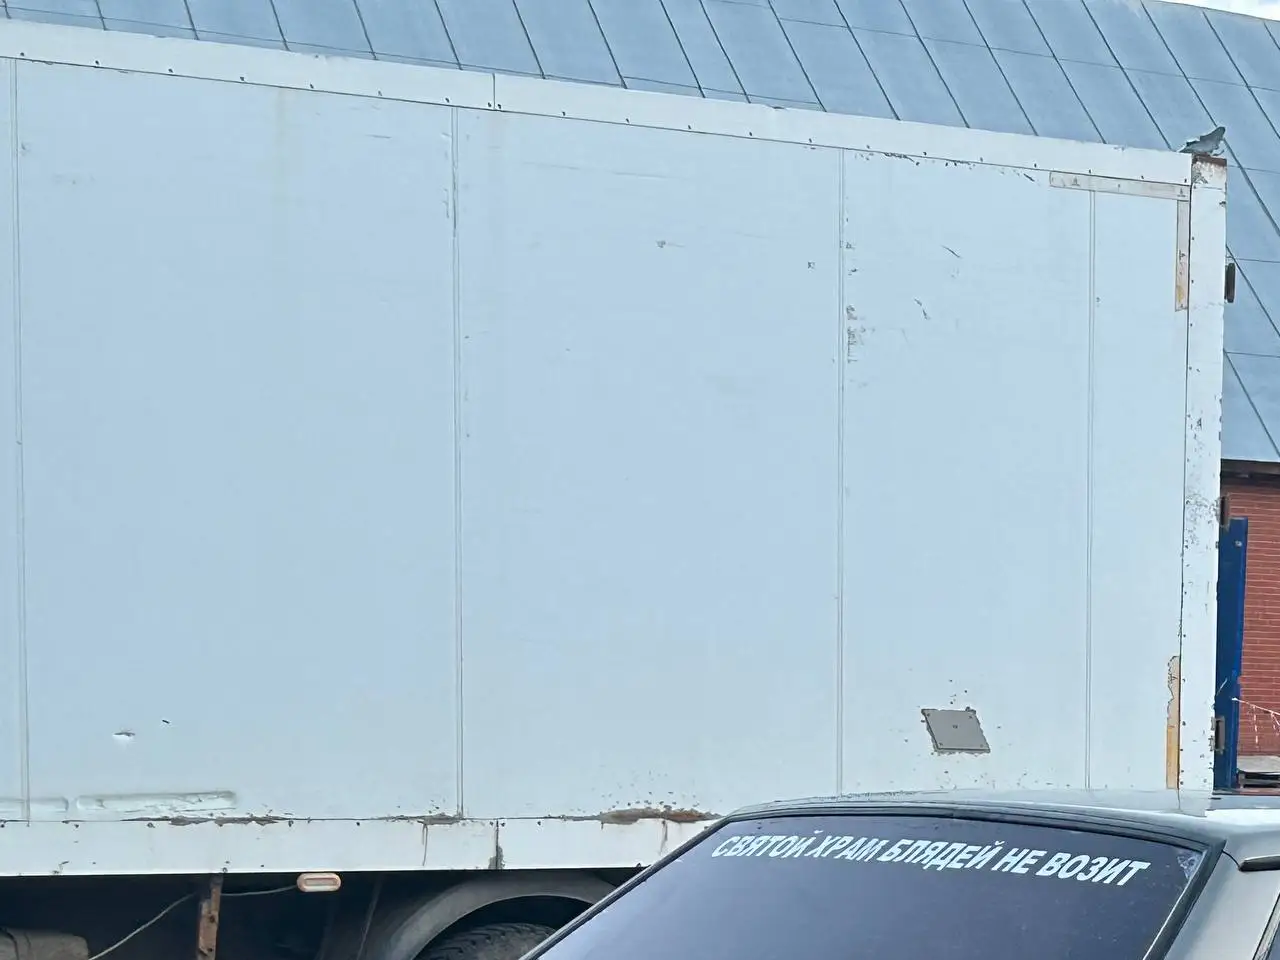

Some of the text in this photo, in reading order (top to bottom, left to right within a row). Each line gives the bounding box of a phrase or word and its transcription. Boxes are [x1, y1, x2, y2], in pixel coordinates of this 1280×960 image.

[711, 830, 1151, 886] СВЯТОЙ ХРАМ БЛЯДЕЙ НЕ ВОЗИТ
